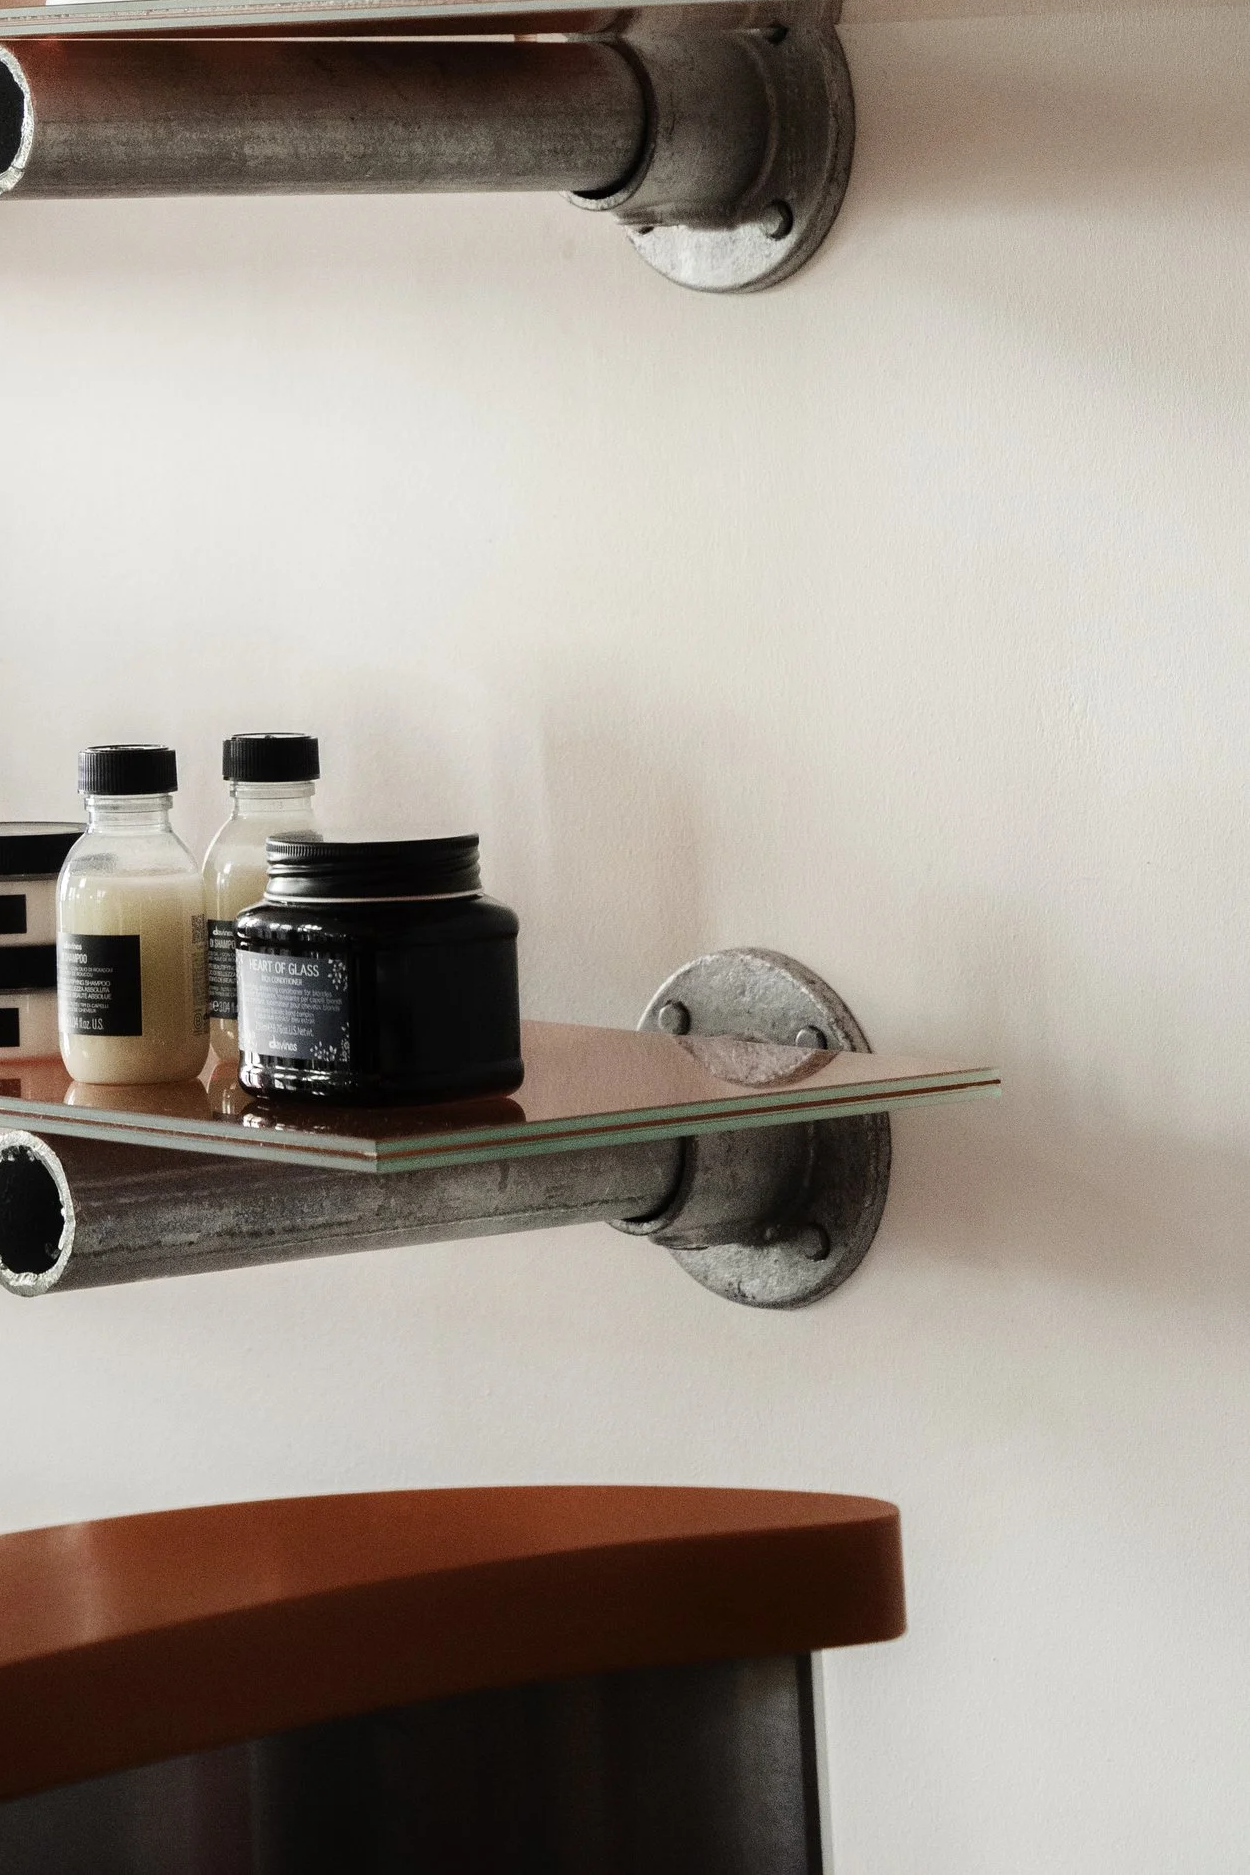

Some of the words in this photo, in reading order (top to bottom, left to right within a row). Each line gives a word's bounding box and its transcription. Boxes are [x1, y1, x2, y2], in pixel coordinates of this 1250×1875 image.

[215, 939, 236, 949] SHAMPO
[249, 958, 272, 973] HEART
[275, 961, 286, 974] OF
[288, 963, 319, 977] GLASS
[269, 1035, 298, 1052] davines
